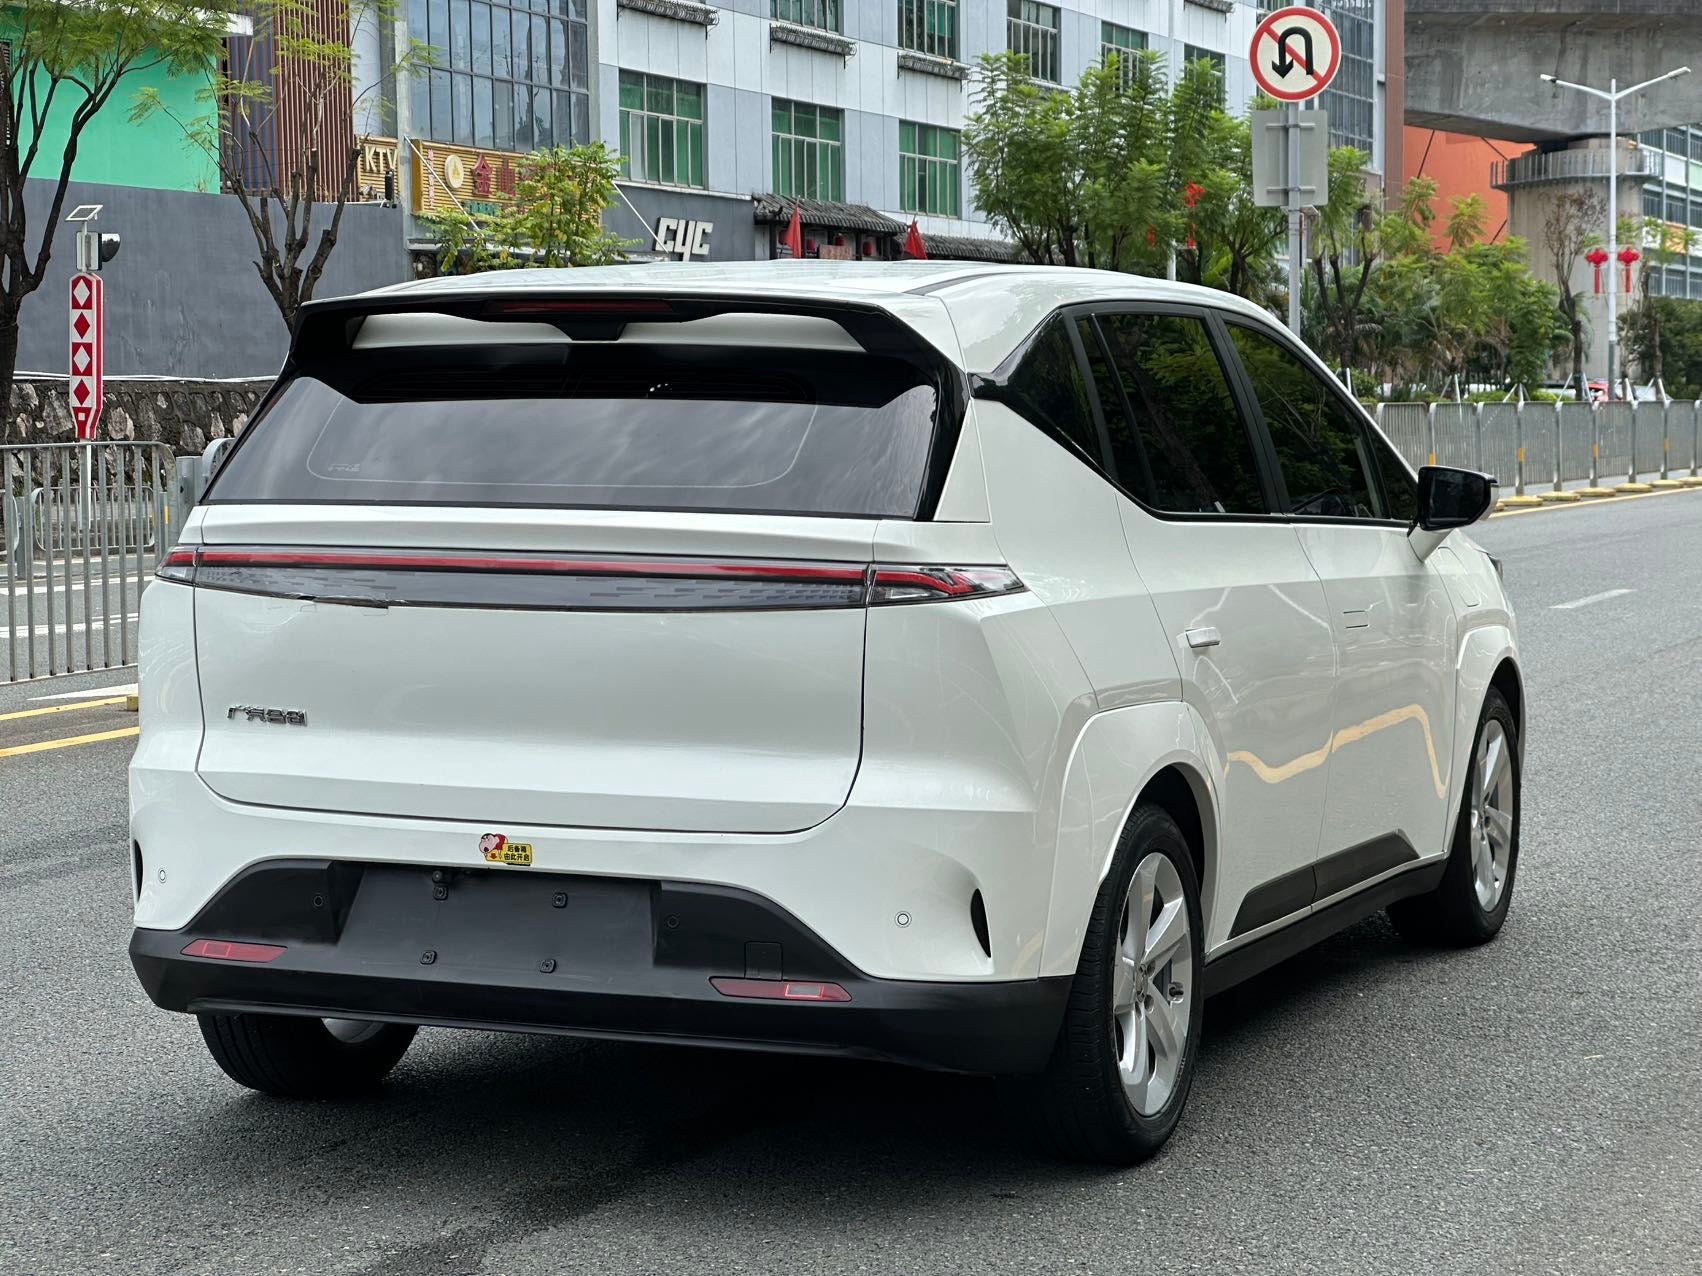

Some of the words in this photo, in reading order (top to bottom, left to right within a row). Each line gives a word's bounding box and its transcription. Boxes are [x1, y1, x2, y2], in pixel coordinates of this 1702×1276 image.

[364, 145, 398, 173] KTV
[504, 852, 530, 862] 由此开启
